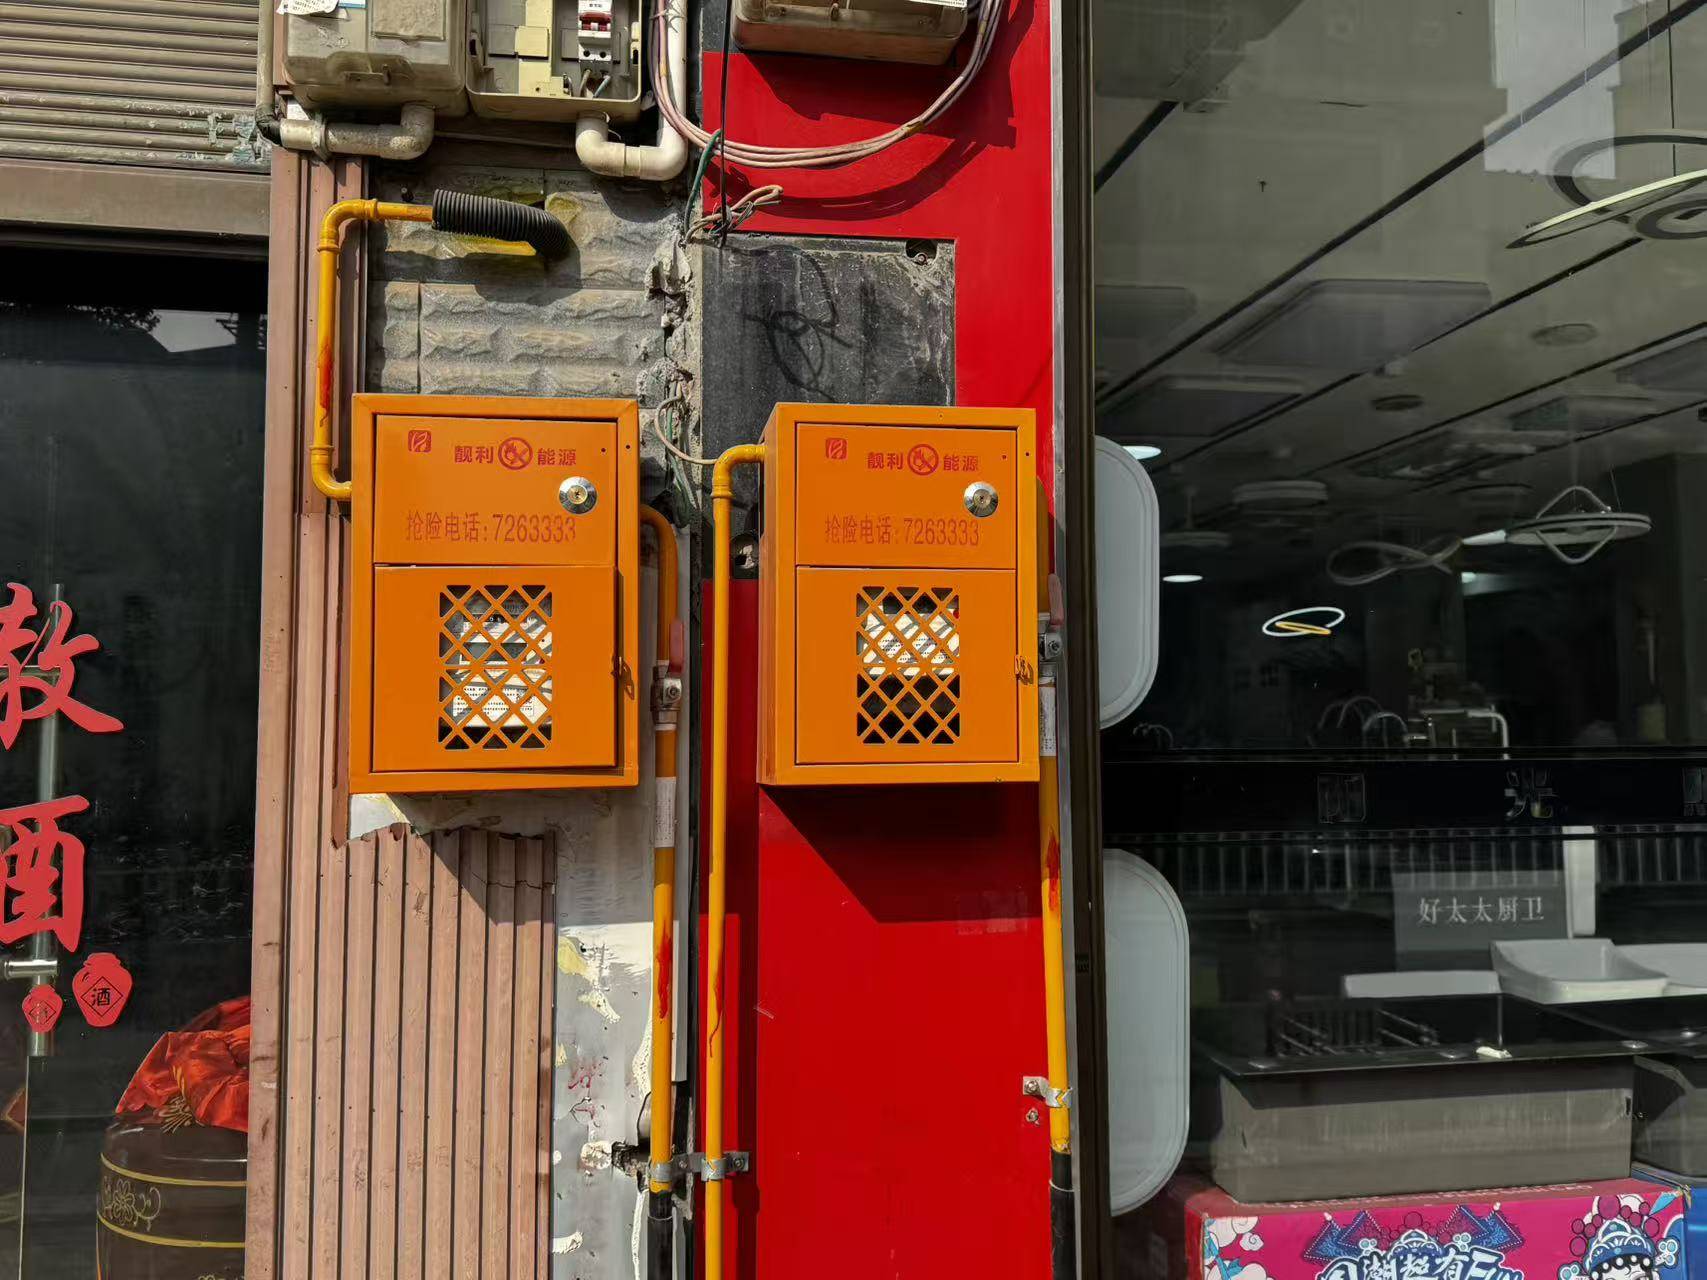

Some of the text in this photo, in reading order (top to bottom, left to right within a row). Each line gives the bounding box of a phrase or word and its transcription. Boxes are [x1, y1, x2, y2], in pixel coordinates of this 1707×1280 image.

[455, 445, 577, 466] 靓利 能源
[867, 452, 979, 472] 靓利 能源
[1417, 896, 1545, 925] 好太太厨卫
[91, 987, 111, 1007] 酒
